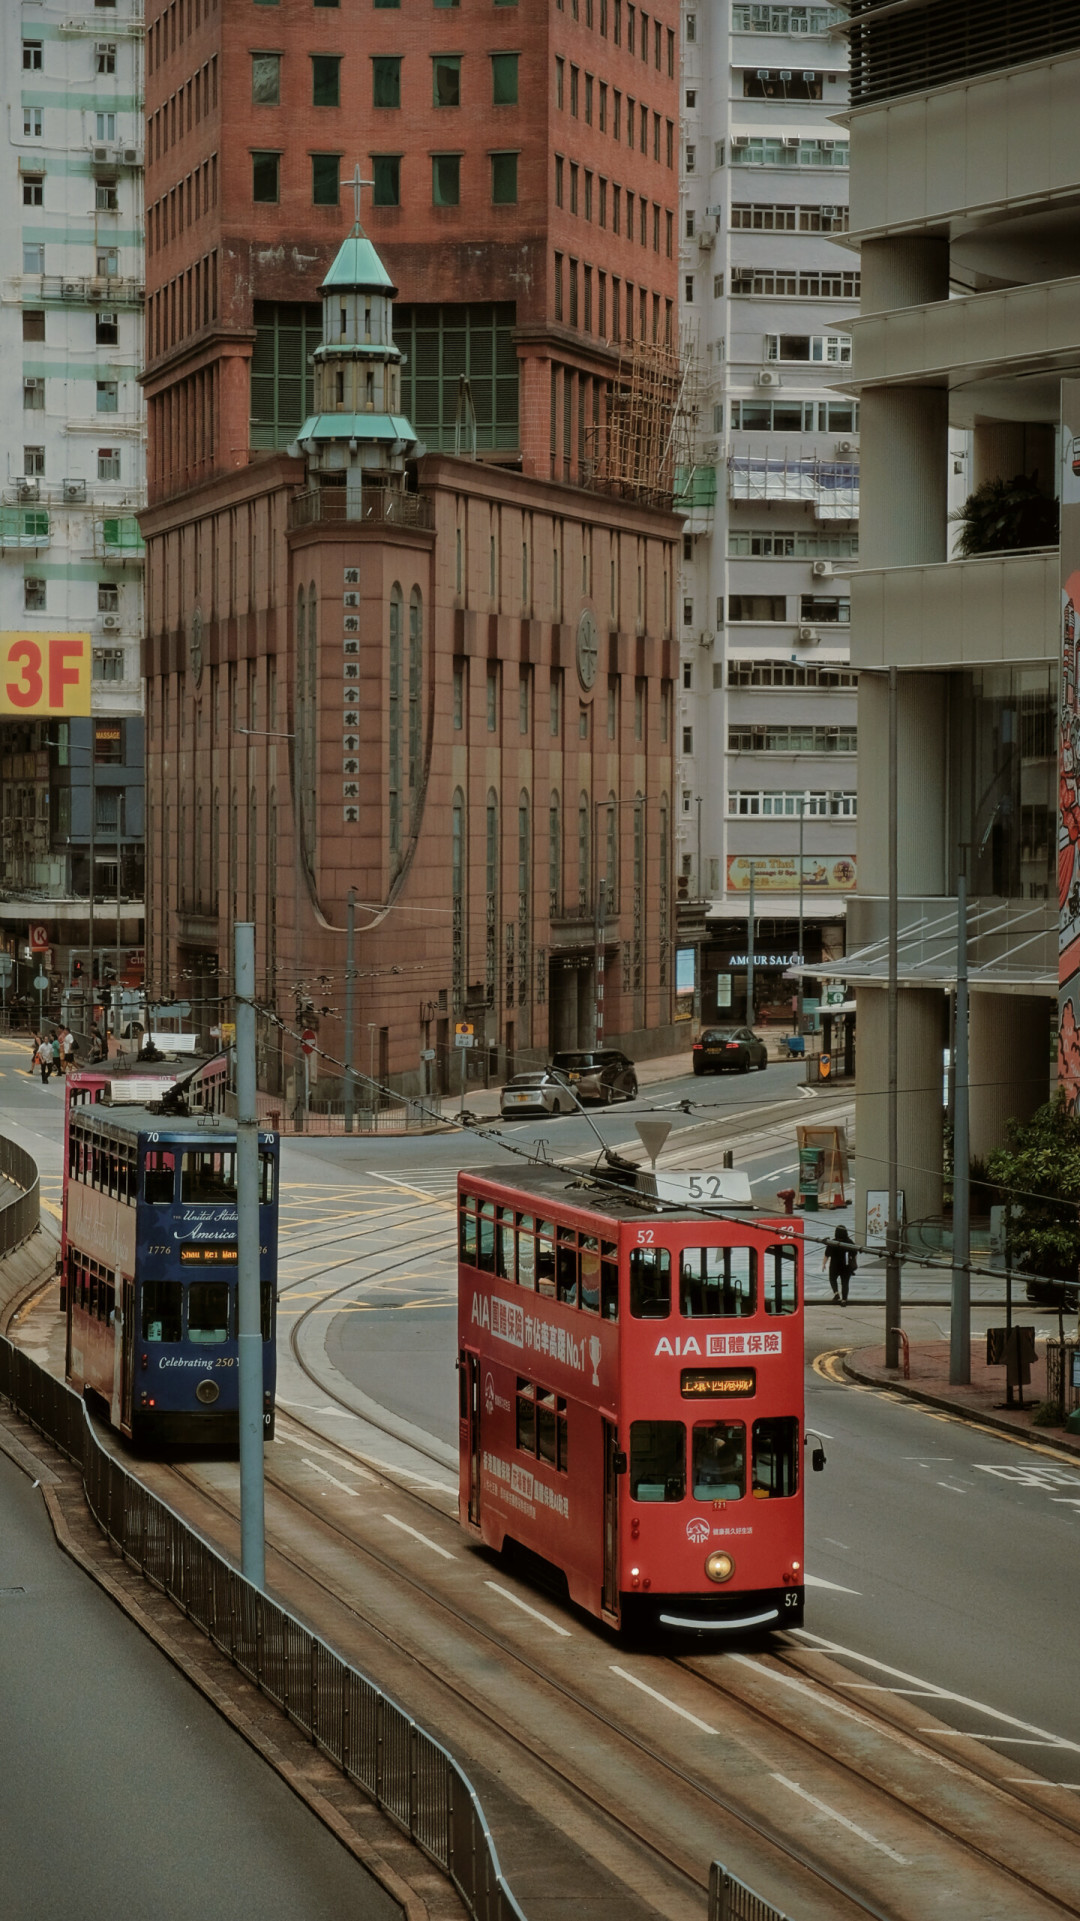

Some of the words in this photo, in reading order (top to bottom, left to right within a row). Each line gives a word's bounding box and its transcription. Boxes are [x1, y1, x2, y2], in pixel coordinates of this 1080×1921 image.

[6, 639, 84, 708] 3F
[95, 731, 121, 740] MASSAGE
[147, 1132, 159, 1143] 70
[264, 1134, 275, 1145] 70
[688, 1175, 724, 1199] 52
[183, 1209, 214, 1222] United
[173, 1222, 238, 1240] America
[636, 1229, 655, 1244] 52
[148, 1245, 172, 1255] 1776
[471, 1291, 490, 1331] AIA
[491, 1297, 523, 1347] 團體保險
[654, 1335, 702, 1357] AIA
[708, 1333, 781, 1356] 團體保險
[158, 1356, 214, 1371] Celebrating
[215, 1357, 235, 1368] 250
[713, 1502, 726, 1510] 121
[687, 1533, 709, 1544] AIA
[784, 1593, 798, 1607] 52
